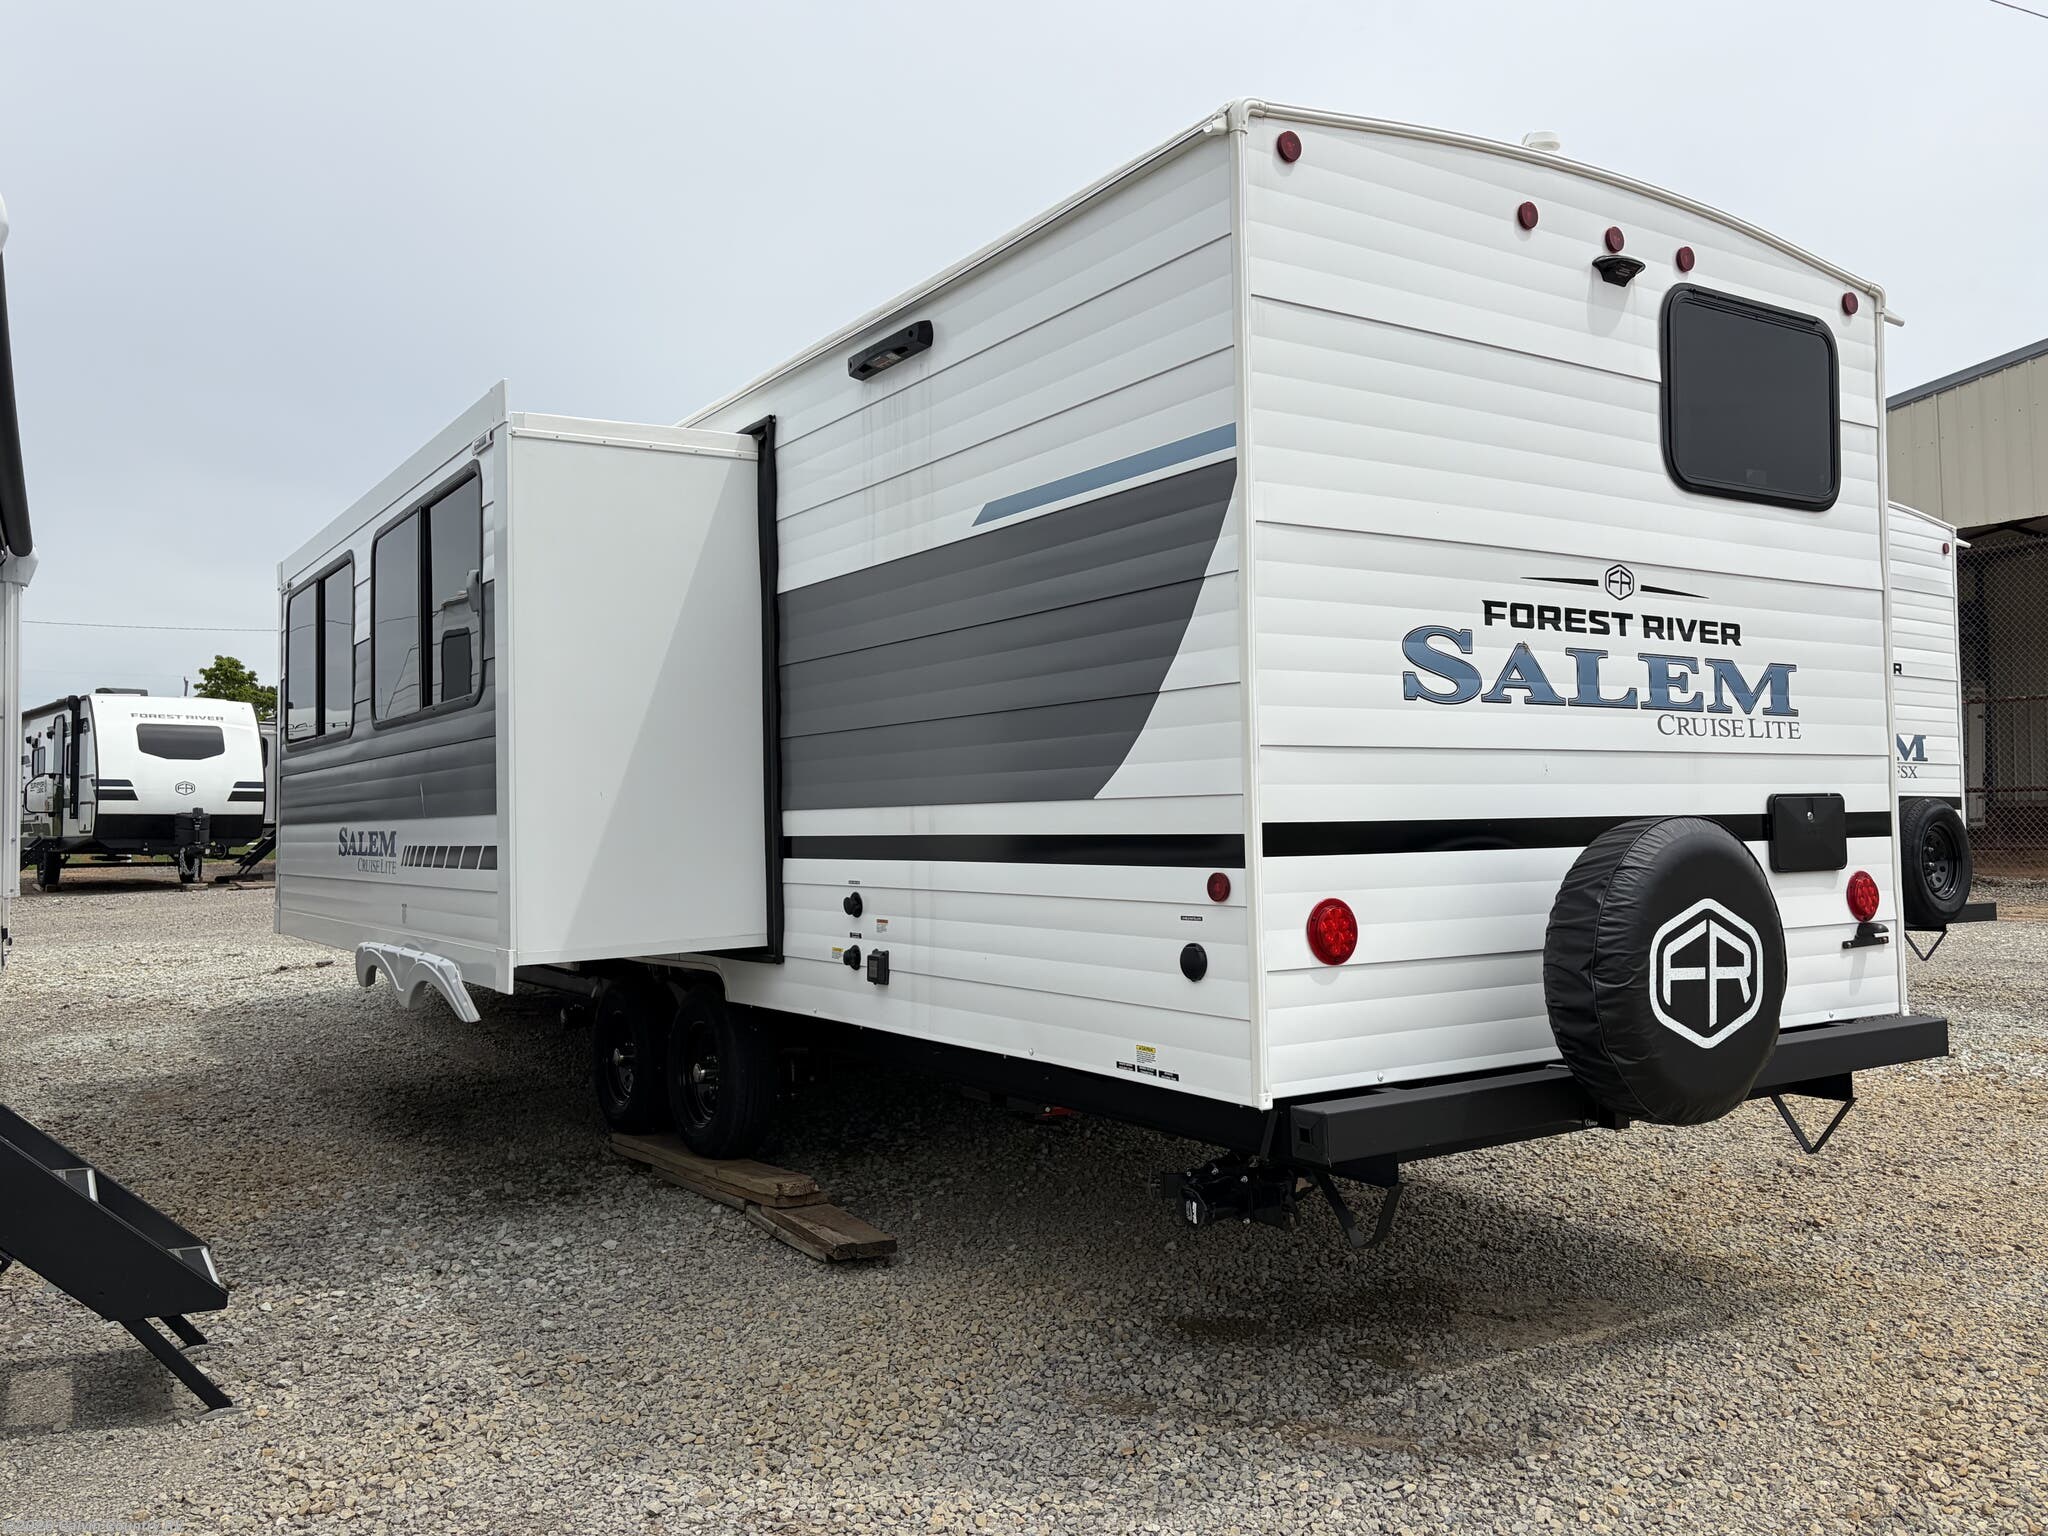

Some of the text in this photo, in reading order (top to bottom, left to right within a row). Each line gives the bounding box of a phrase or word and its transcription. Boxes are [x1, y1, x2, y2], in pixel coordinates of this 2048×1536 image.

[1481, 600, 1742, 647] FOREST RIVER
[1402, 625, 1799, 717] SALEM
[130, 712, 183, 720] FOREST
[338, 826, 397, 858] SALEM
